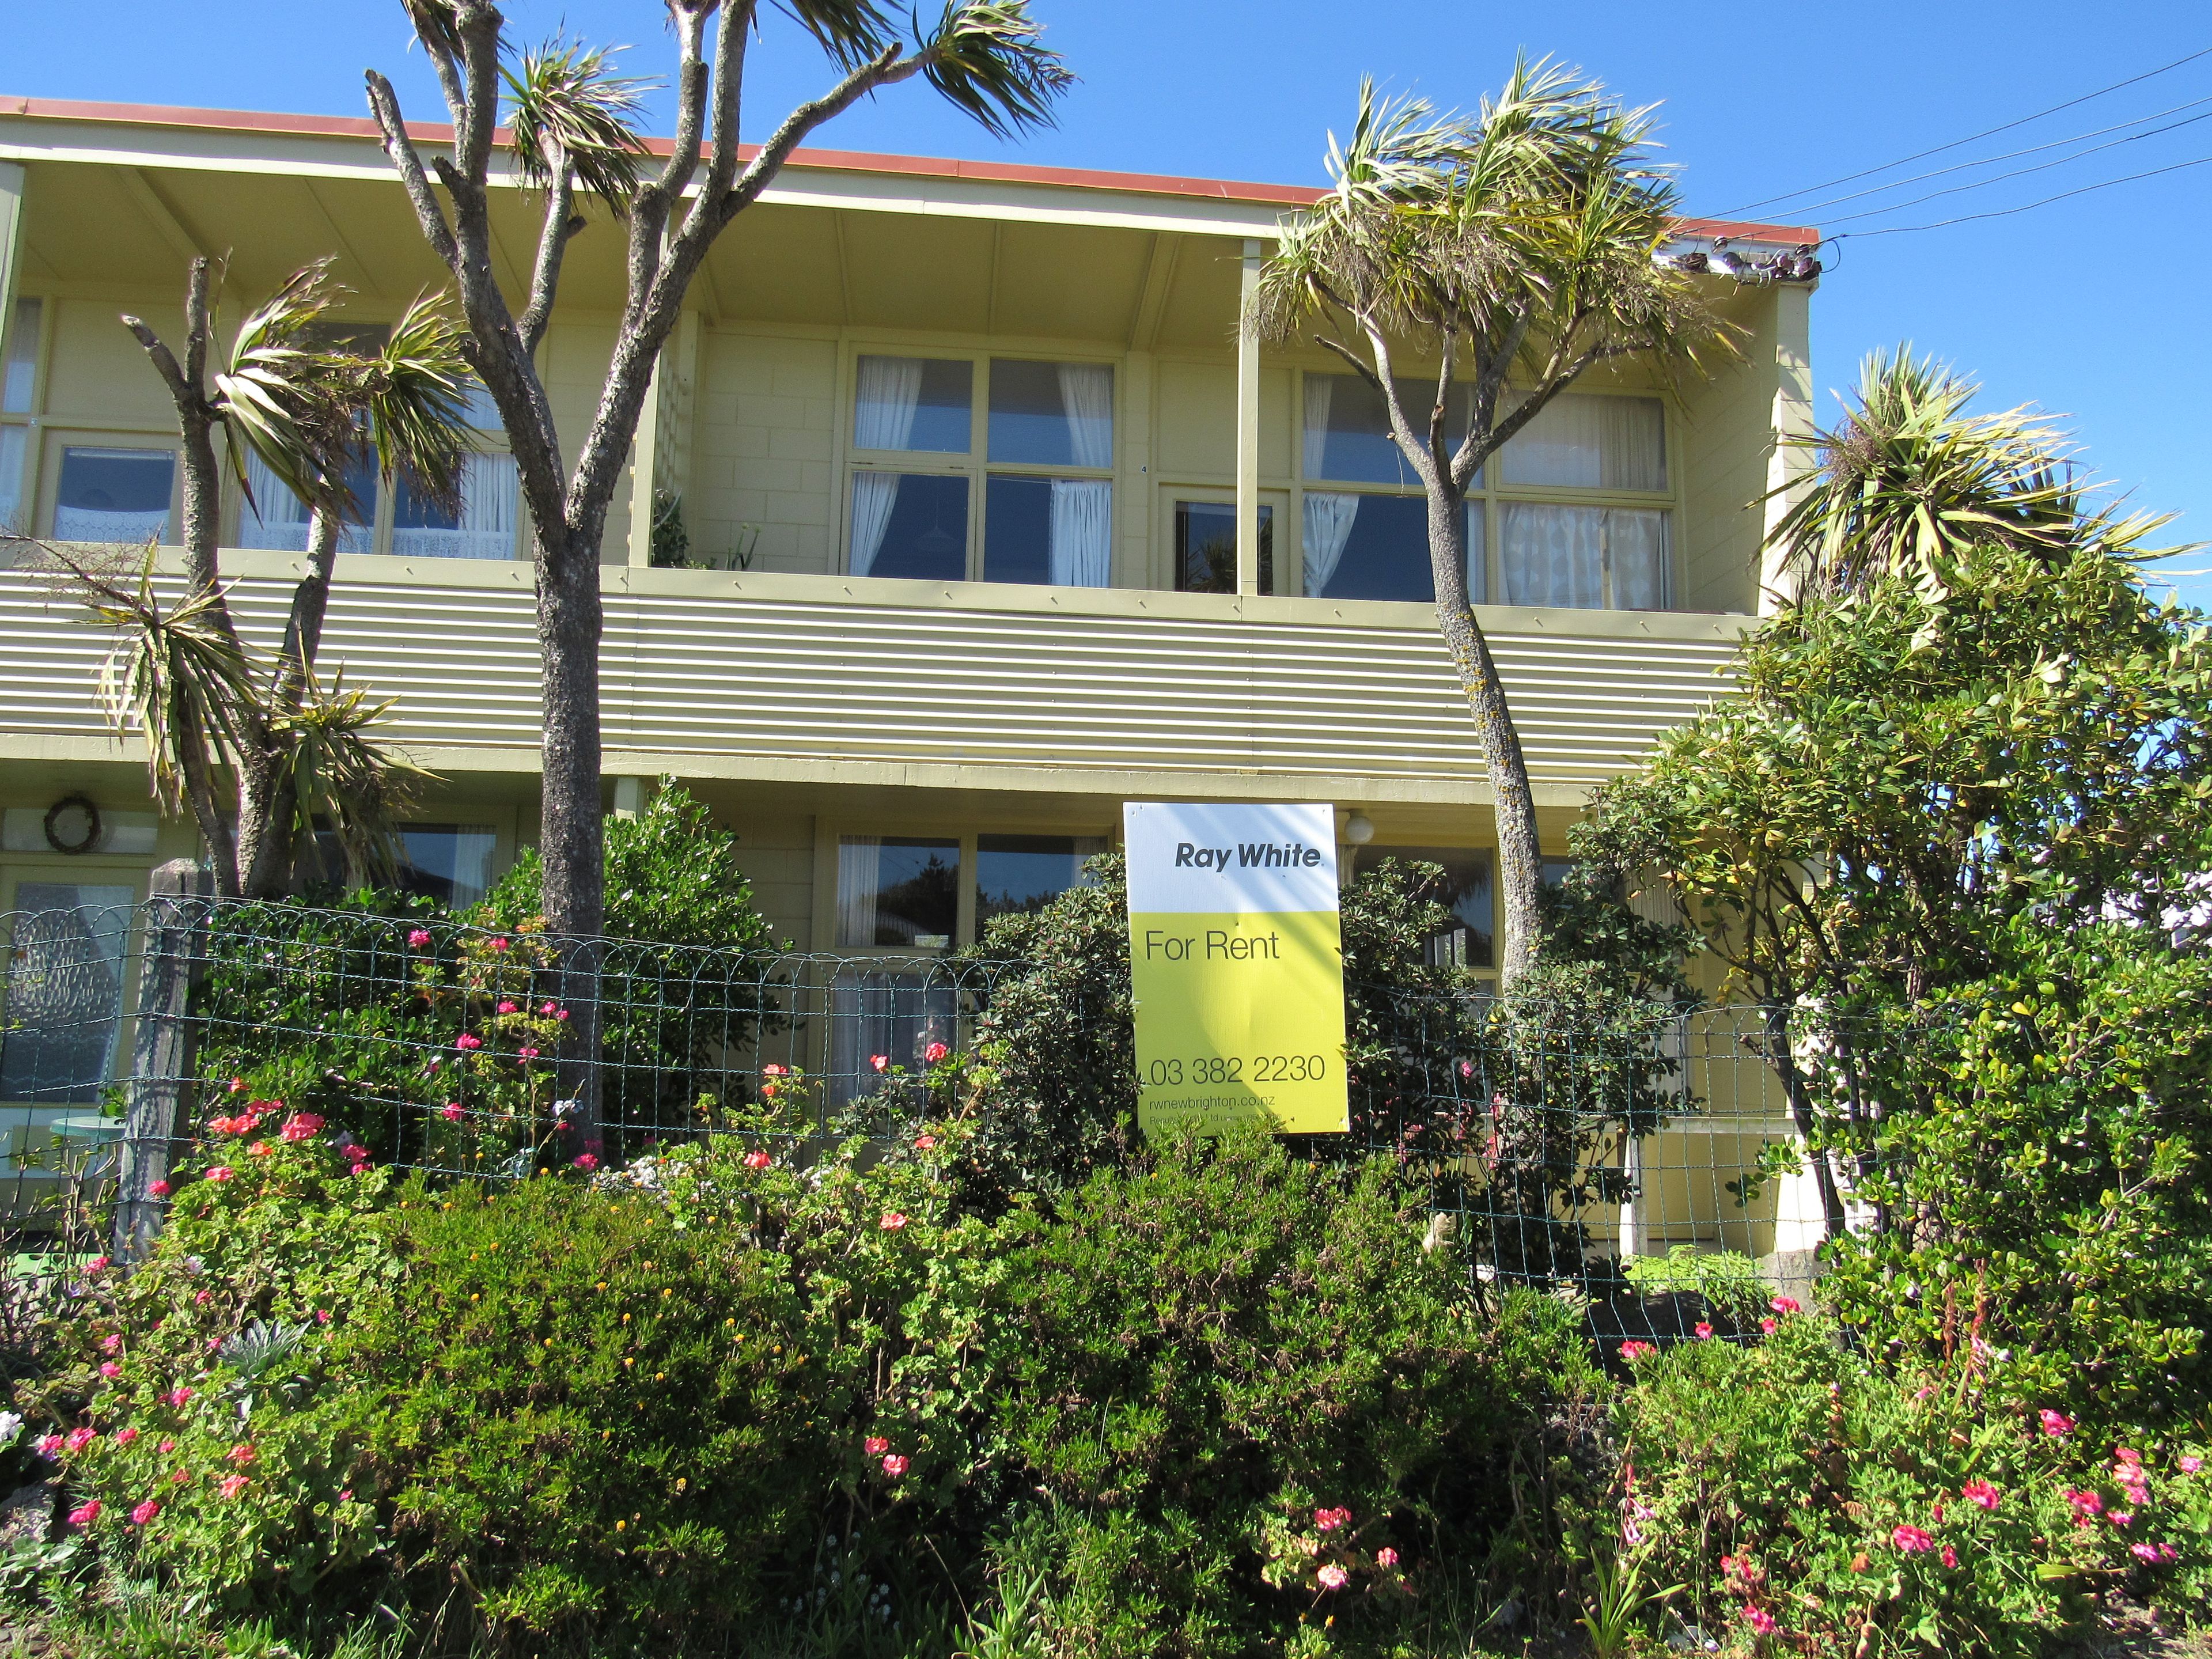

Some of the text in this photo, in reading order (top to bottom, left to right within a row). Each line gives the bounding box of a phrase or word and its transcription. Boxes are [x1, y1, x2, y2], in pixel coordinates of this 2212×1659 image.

[1175, 843, 1321, 873] Ray White
[1145, 930, 1280, 960] For Rent
[1150, 1055, 1325, 1086] 03 382 2230
[1149, 1096, 1275, 1111] rwnewbrighton.co.nz
